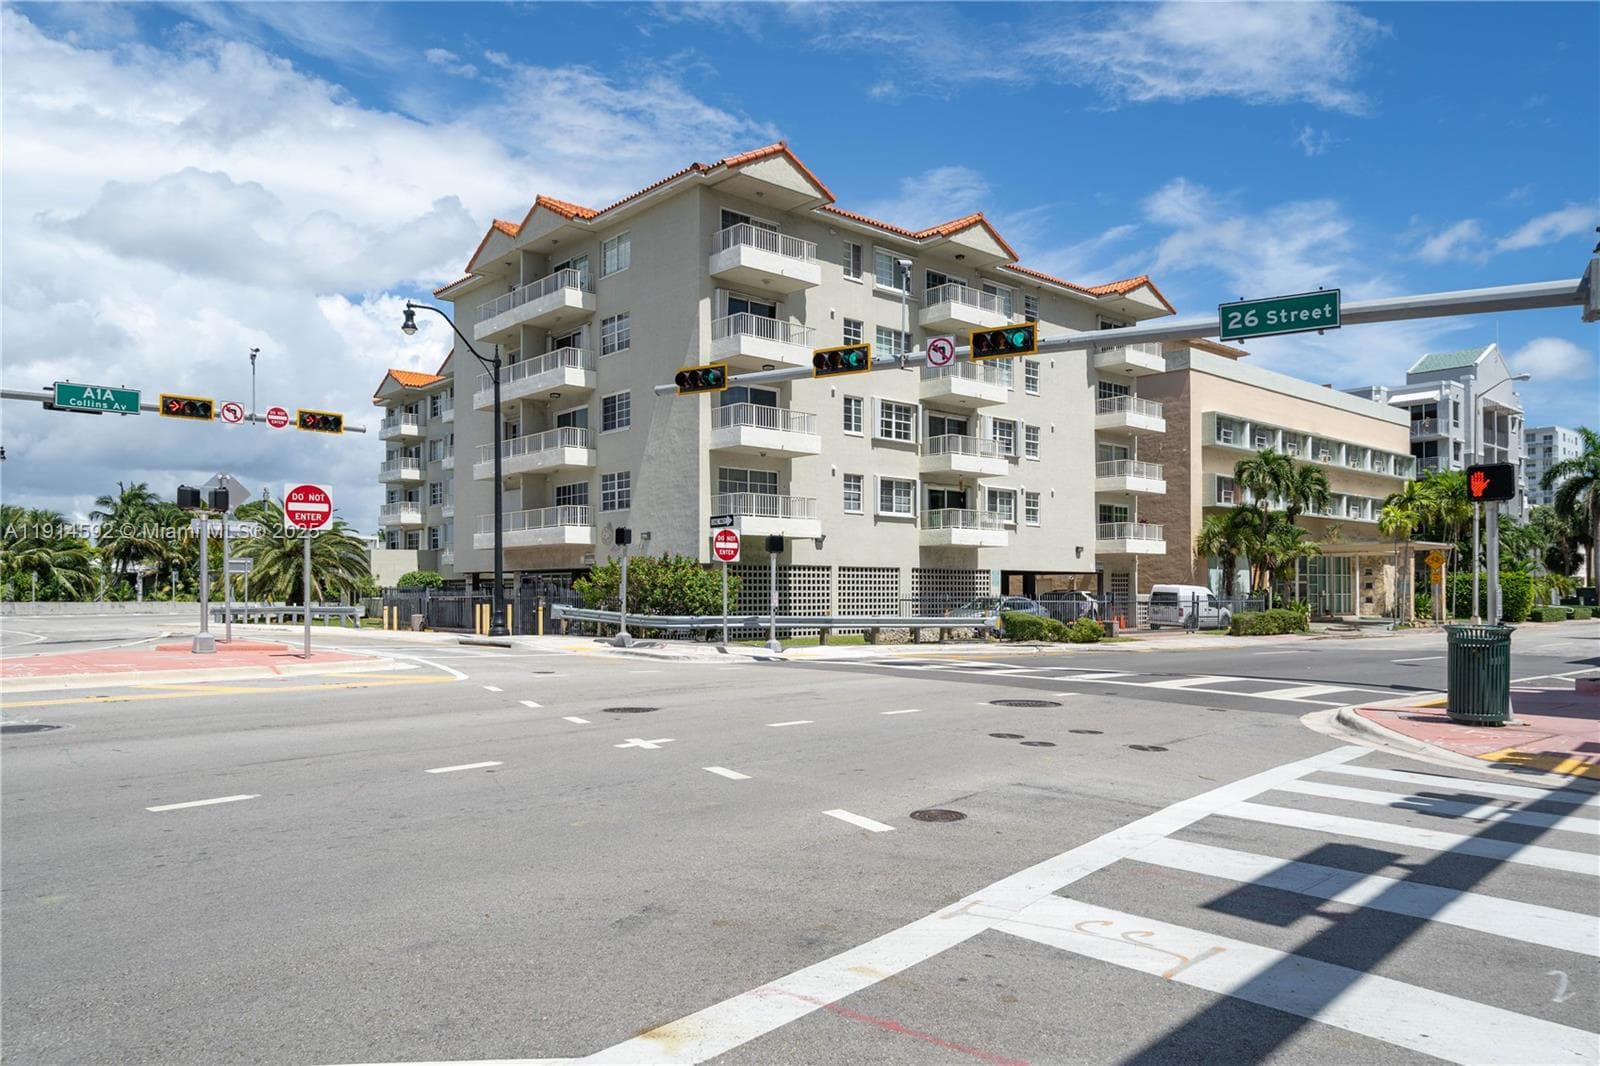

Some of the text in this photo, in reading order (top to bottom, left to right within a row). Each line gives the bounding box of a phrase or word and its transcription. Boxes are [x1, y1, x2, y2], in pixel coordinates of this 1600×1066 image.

[1228, 304, 1332, 329] 26 Street
[83, 387, 115, 402] A1A
[69, 398, 127, 411] Collins Av
[292, 493, 325, 502] DO NOT
[295, 513, 322, 521] ENTER
